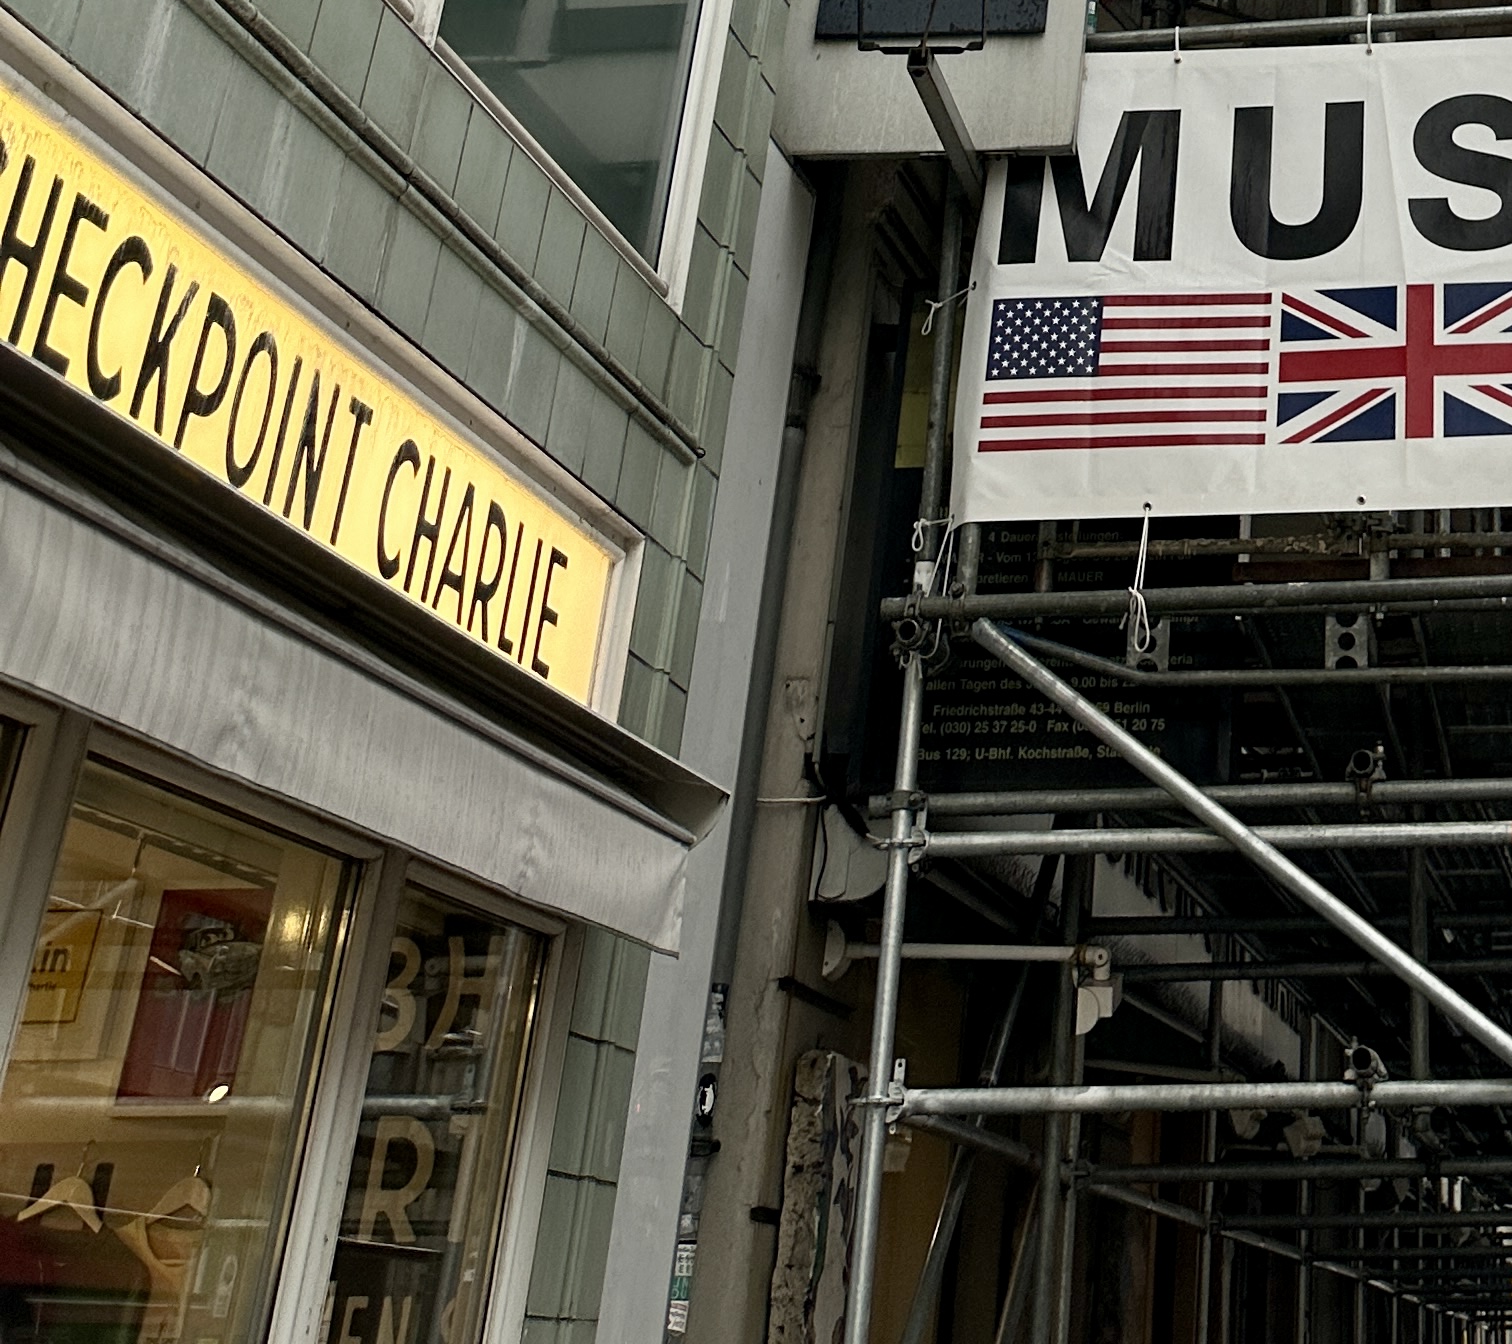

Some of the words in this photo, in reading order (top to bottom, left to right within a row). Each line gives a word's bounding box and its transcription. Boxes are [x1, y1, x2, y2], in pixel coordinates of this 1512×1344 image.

[374, 438, 569, 681] CHARLIE
[932, 703, 1027, 718] Friedrichstraße
[1113, 700, 1152, 715] Berlin
